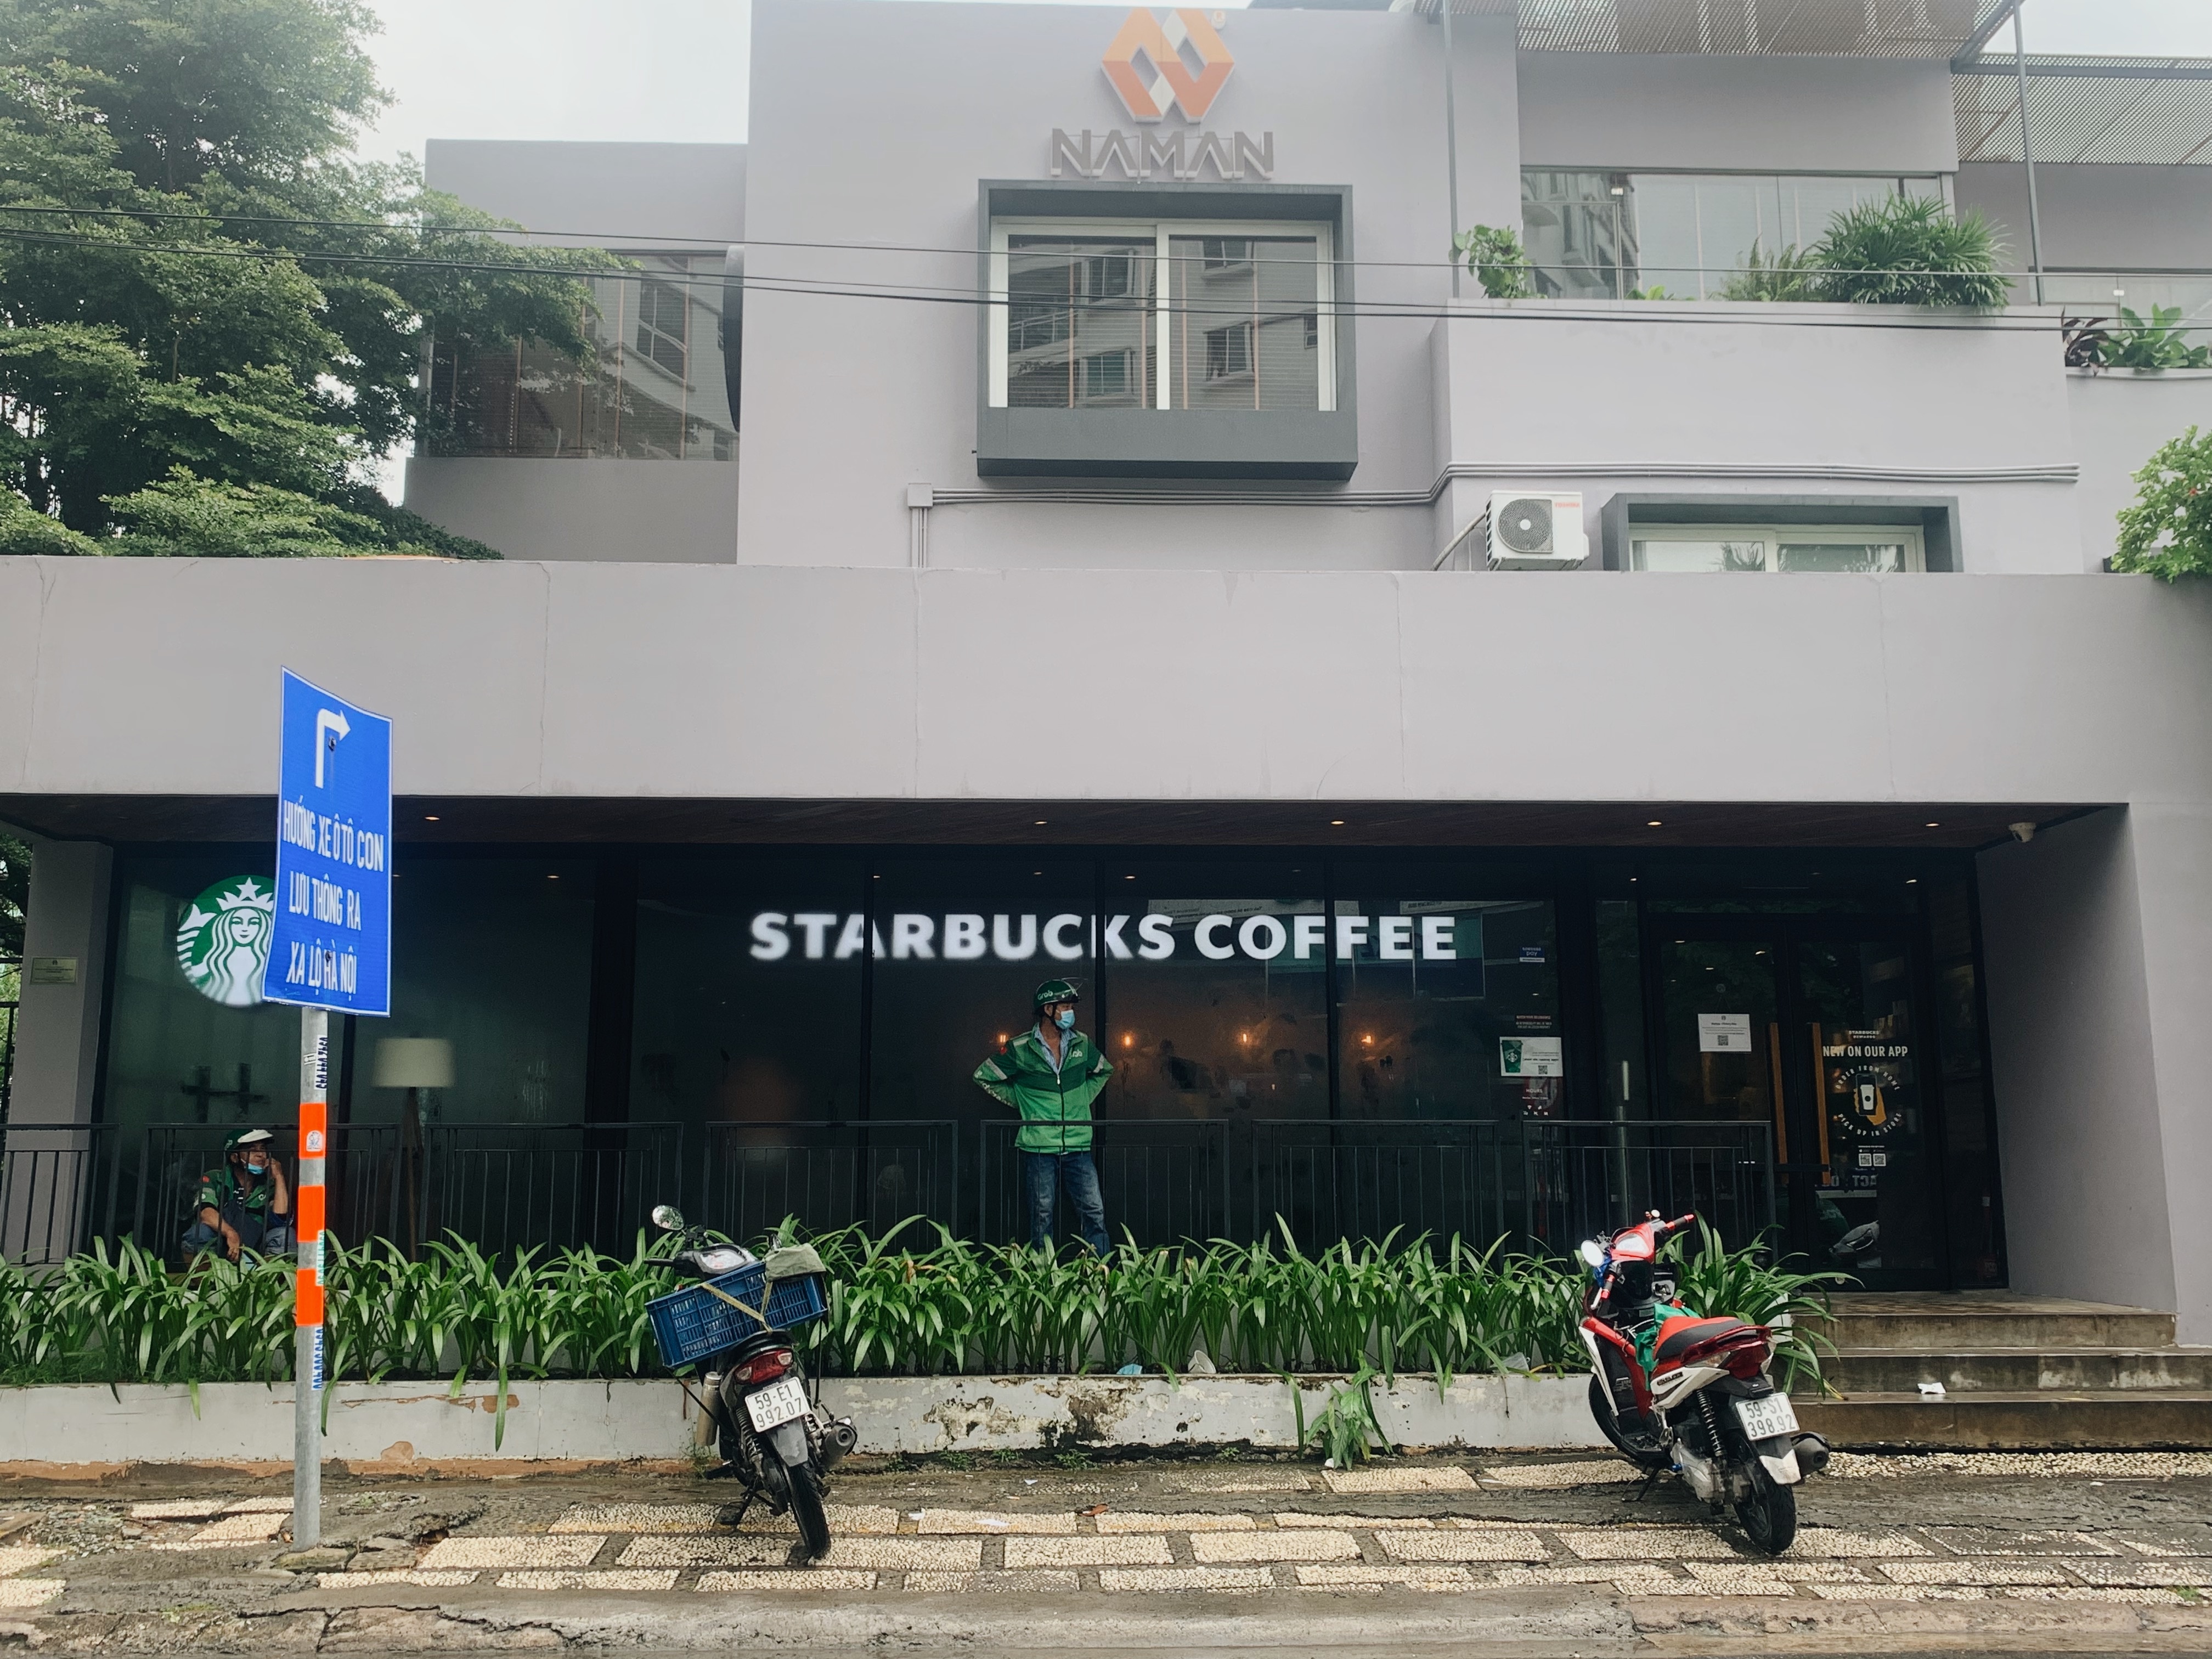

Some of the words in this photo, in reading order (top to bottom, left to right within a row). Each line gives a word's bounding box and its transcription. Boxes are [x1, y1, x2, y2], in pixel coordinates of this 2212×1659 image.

[1051, 128, 1273, 178] NAMAN
[283, 795, 315, 852] HƯỚNG
[318, 814, 332, 858] XE
[333, 813, 340, 861] Ô
[341, 817, 354, 866] TÔ
[357, 830, 384, 872] CON
[289, 871, 309, 917] LƯU
[312, 873, 343, 926] THÔNG
[347, 889, 362, 931] RA
[750, 912, 1175, 960] STARBUCKS
[1194, 914, 1457, 960] COFFEE
[286, 941, 305, 985] XA
[308, 938, 322, 995] LỘ
[324, 939, 338, 991] HÀ
[340, 945, 357, 1001] NỘI
[1037, 989, 1053, 1000] Grab
[1822, 1046, 1845, 1057] NEW
[1848, 1046, 1861, 1057] ON
[1865, 1046, 1885, 1057] OUR
[1888, 1046, 1908, 1057] APP
[1835, 1068, 1855, 1089] ORDER
[1883, 1071, 1900, 1090] HOME
[1838, 1114, 1853, 1130] PICK
[1883, 1113, 1901, 1133] STORE
[754, 1384, 793, 1409] 59-E1
[1745, 1397, 1783, 1418] 59-S1
[756, 1397, 802, 1427] 992.07
[1748, 1414, 1796, 1437] 398.92
